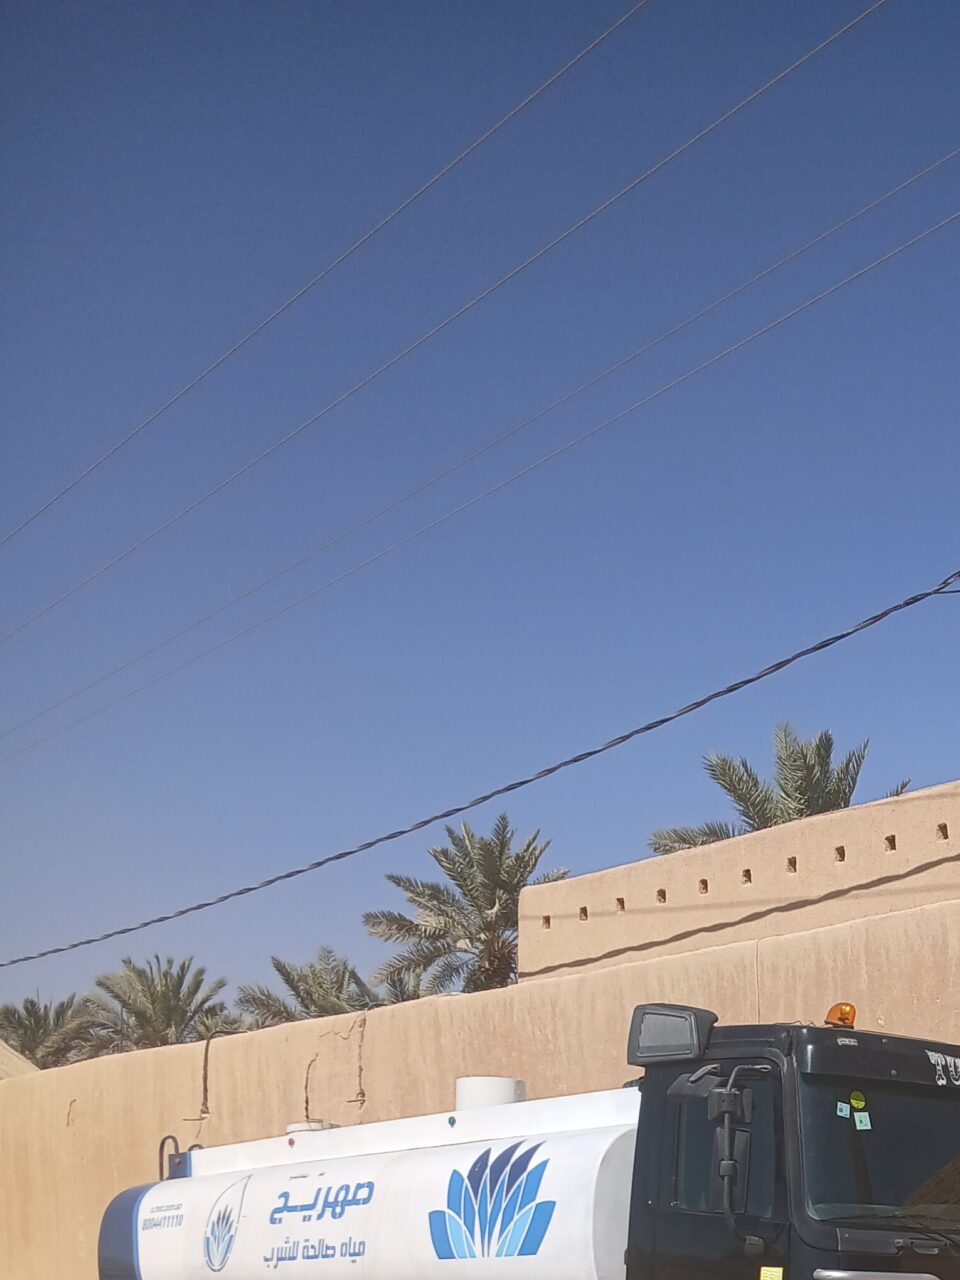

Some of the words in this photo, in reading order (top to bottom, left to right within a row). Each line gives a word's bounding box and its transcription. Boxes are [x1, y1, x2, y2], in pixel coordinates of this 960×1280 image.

[269, 1181, 375, 1225] صهريج
[263, 1236, 300, 1269] للشرب
[302, 1238, 337, 1260] صالحة
[340, 1236, 366, 1263] مياه
